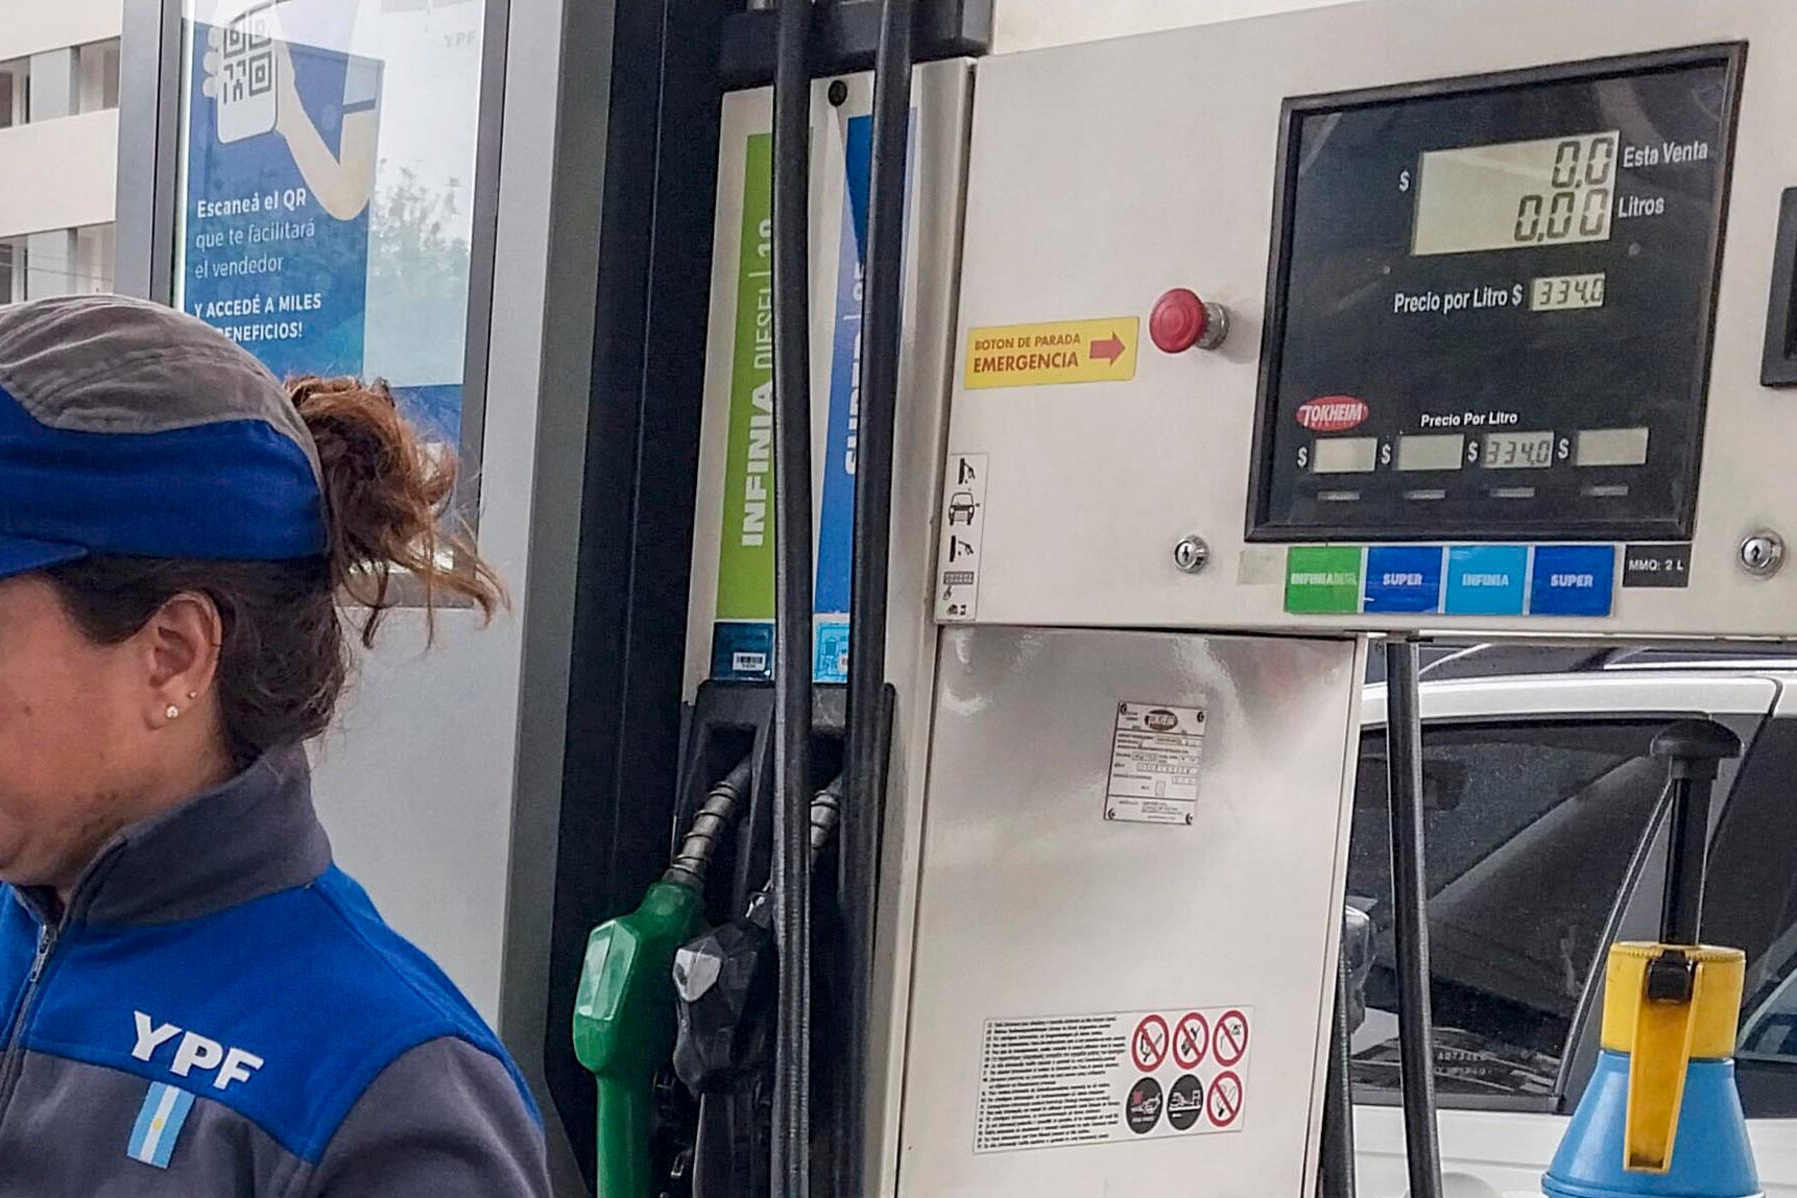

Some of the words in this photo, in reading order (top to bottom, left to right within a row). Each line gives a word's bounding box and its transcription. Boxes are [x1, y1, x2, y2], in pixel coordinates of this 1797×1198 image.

[1623, 145, 1659, 168] Esta
[1663, 140, 1709, 163] Venta
[1399, 171, 1410, 191] $
[197, 192, 260, 218] Escaneá
[264, 191, 279, 210] el
[283, 188, 307, 211] QR
[1618, 196, 1665, 218] Litros
[196, 231, 224, 252] que
[229, 228, 244, 246] te
[247, 218, 315, 243] facilitará
[195, 259, 208, 279] el
[212, 254, 284, 278] vendedor
[194, 302, 203, 319] Y
[206, 294, 261, 318] ACCEDÉ
[264, 297, 274, 314] A
[279, 293, 322, 312] MILES
[1394, 291, 1440, 314] Precio
[1443, 290, 1470, 314] por
[1472, 285, 1508, 308] Litro
[1512, 284, 1524, 306] $
[974, 338, 1015, 351] BOTON
[1017, 336, 1032, 349] DE
[1034, 333, 1081, 347] PARADA
[973, 351, 1079, 373] EMERGENCIA
[1299, 402, 1364, 427] TOKHEIM
[1420, 414, 1460, 428] Precio
[1463, 412, 1486, 426] Por
[1489, 411, 1518, 425] Litro
[741, 379, 773, 546] INFINIA
[1297, 446, 1308, 467] $
[1381, 443, 1392, 464] $
[1467, 441, 1478, 462] $
[1558, 437, 1570, 459] $
[1665, 559, 1673, 571] 2
[1676, 559, 1684, 570] L
[1383, 572, 1423, 586] SUPER
[1550, 574, 1594, 587] SUPER
[130, 1010, 265, 1090] YPF
